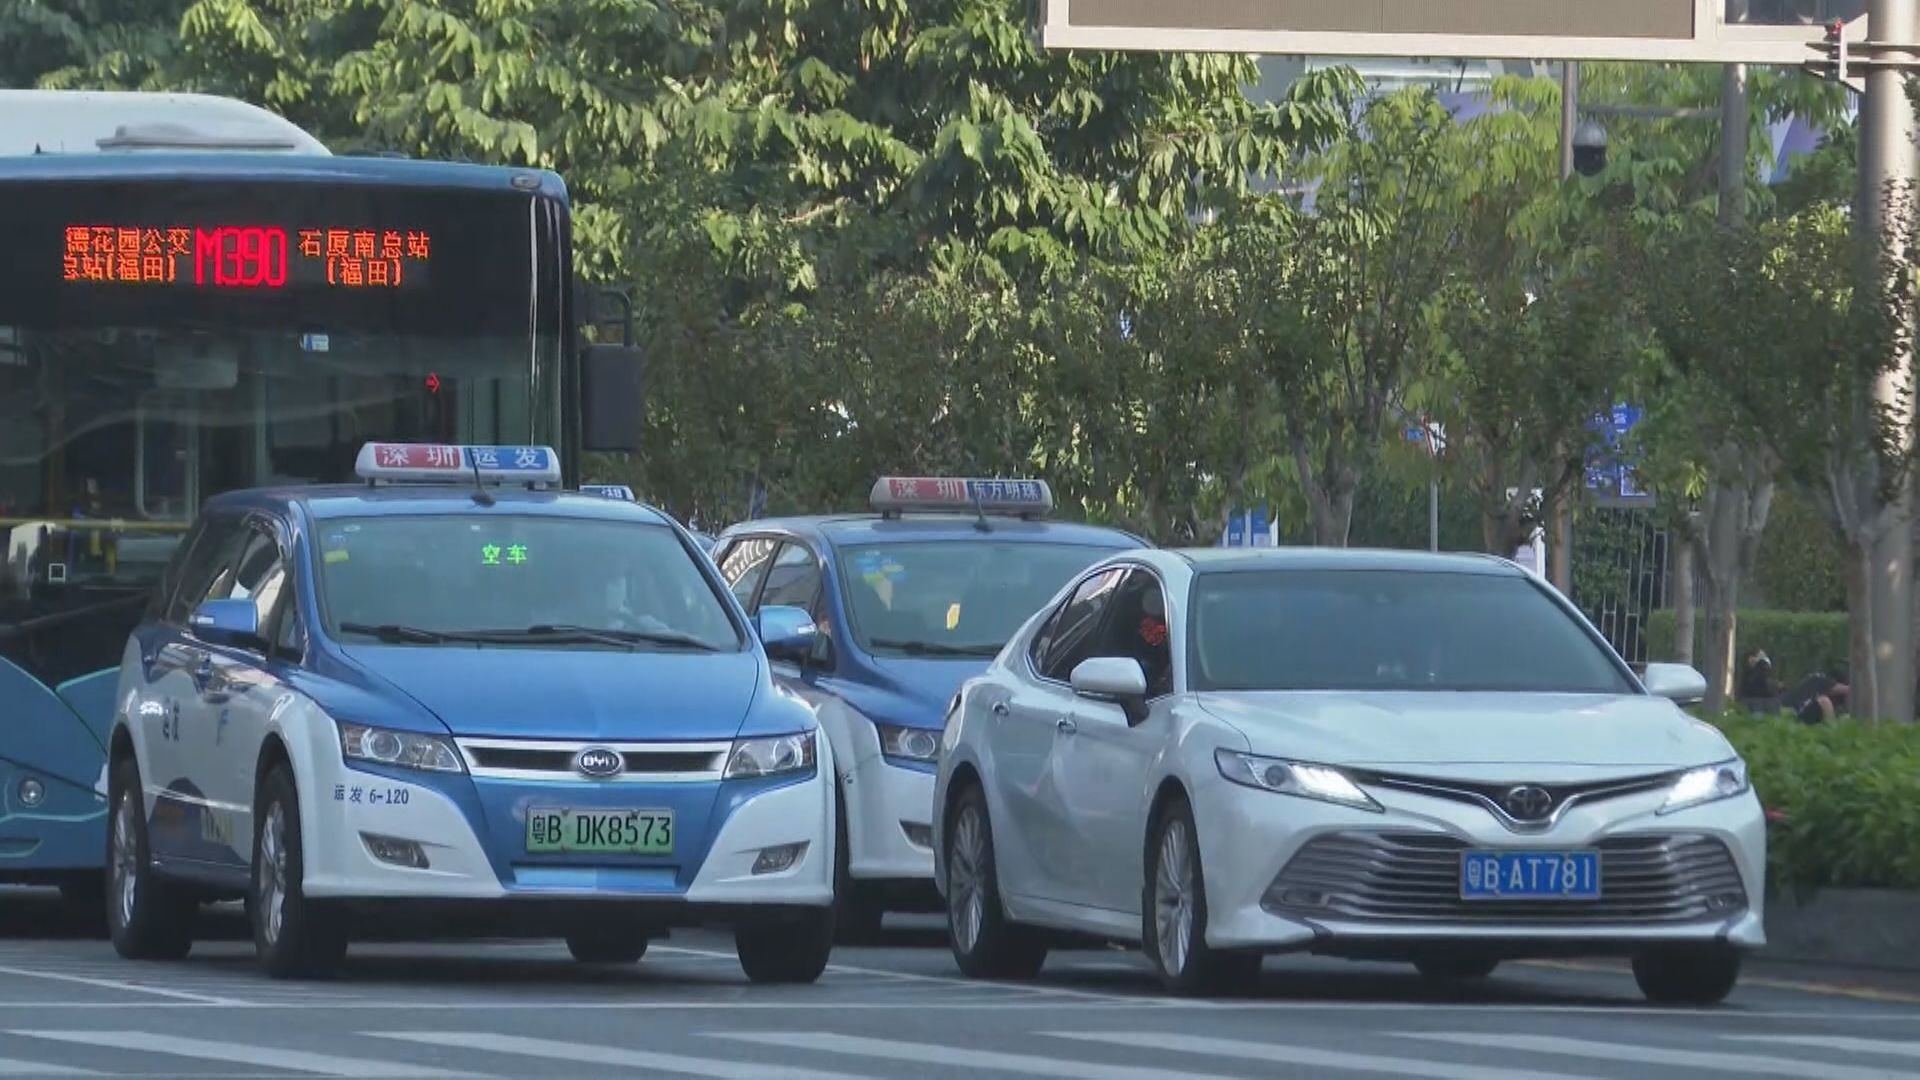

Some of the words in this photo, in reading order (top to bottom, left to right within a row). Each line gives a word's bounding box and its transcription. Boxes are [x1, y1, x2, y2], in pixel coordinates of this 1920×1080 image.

[298, 229, 430, 259] 石厦南总站
[194, 226, 288, 287] M390
[383, 446, 455, 467] 深圳
[471, 448, 541, 468] 运发
[896, 479, 960, 500] 深圳
[973, 480, 1038, 500] 东方明珠
[481, 543, 528, 565] 空车
[369, 788, 409, 805] 6-120
[576, 814, 671, 846] DK8573
